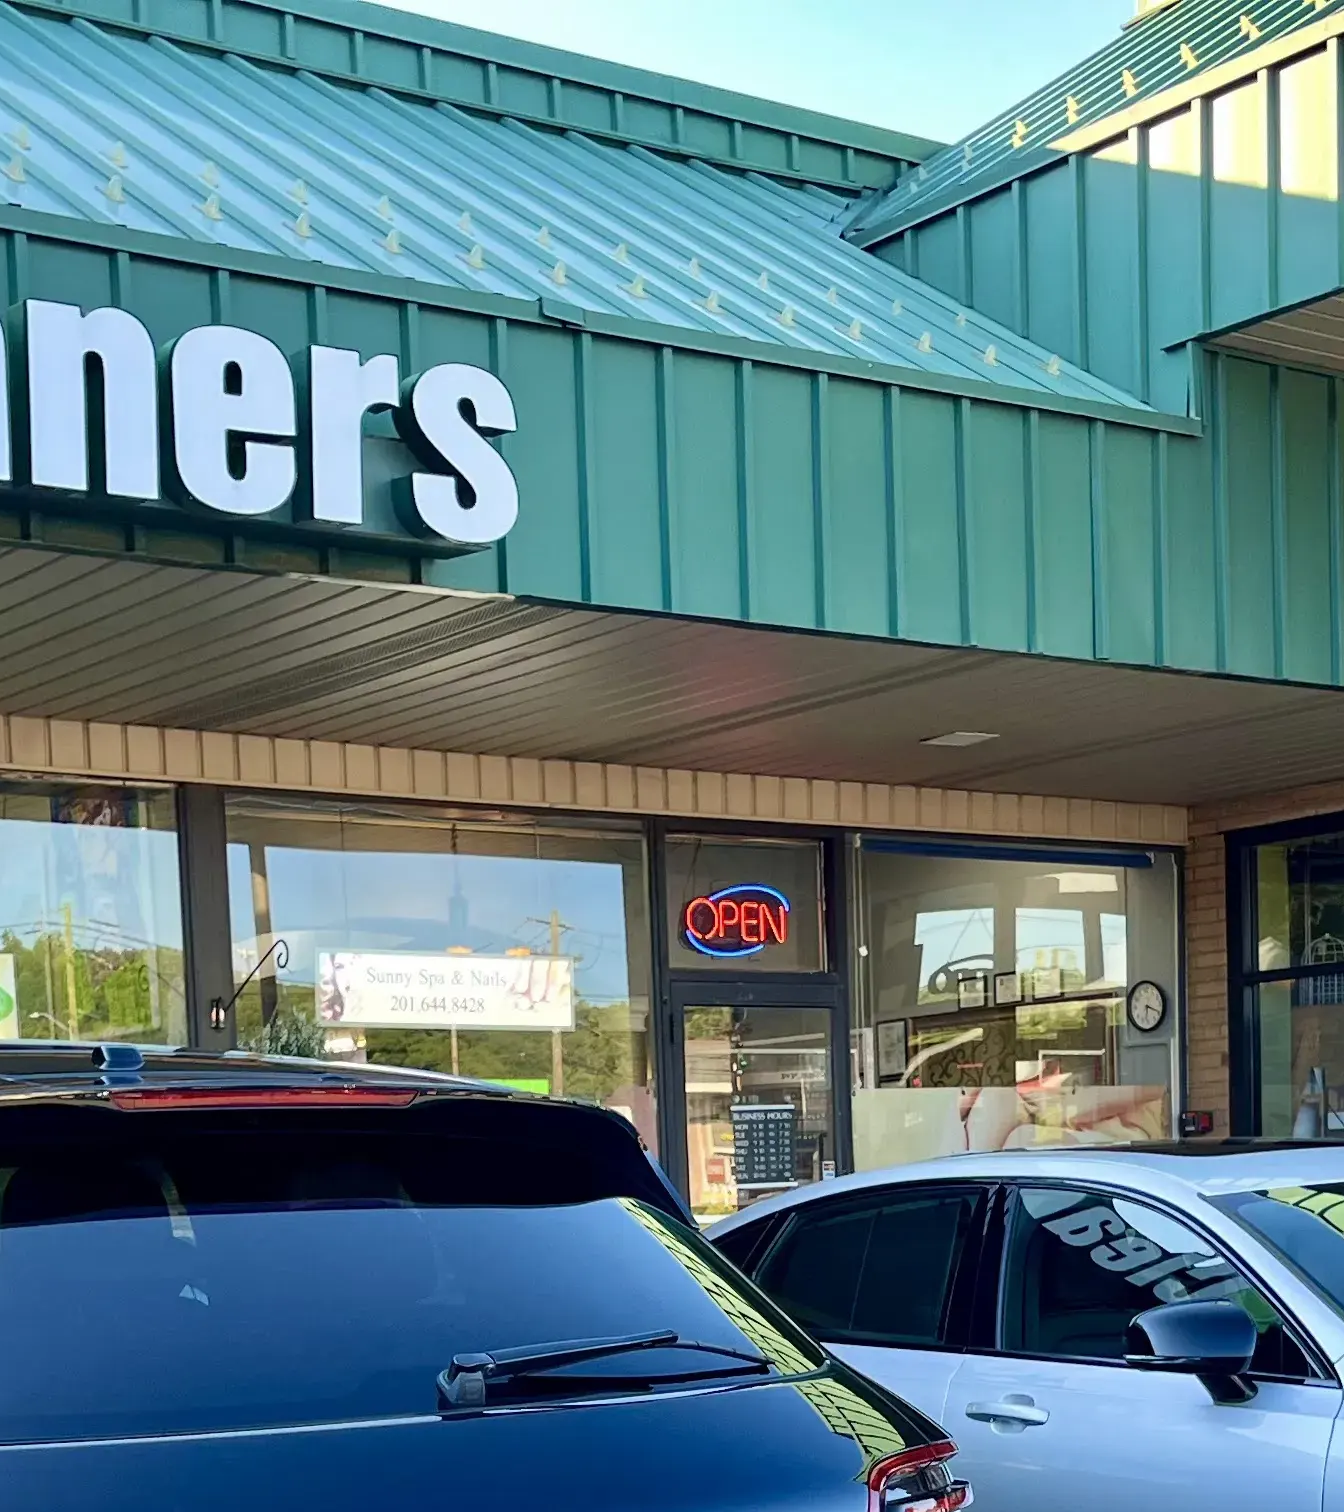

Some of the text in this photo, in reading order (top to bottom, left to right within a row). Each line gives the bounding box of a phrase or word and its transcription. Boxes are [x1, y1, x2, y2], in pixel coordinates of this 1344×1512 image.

[685, 896, 788, 944] OPEN
[366, 967, 507, 988] Sunny Spa & Nails
[733, 1112, 792, 1121] BUSINESS HOURS
